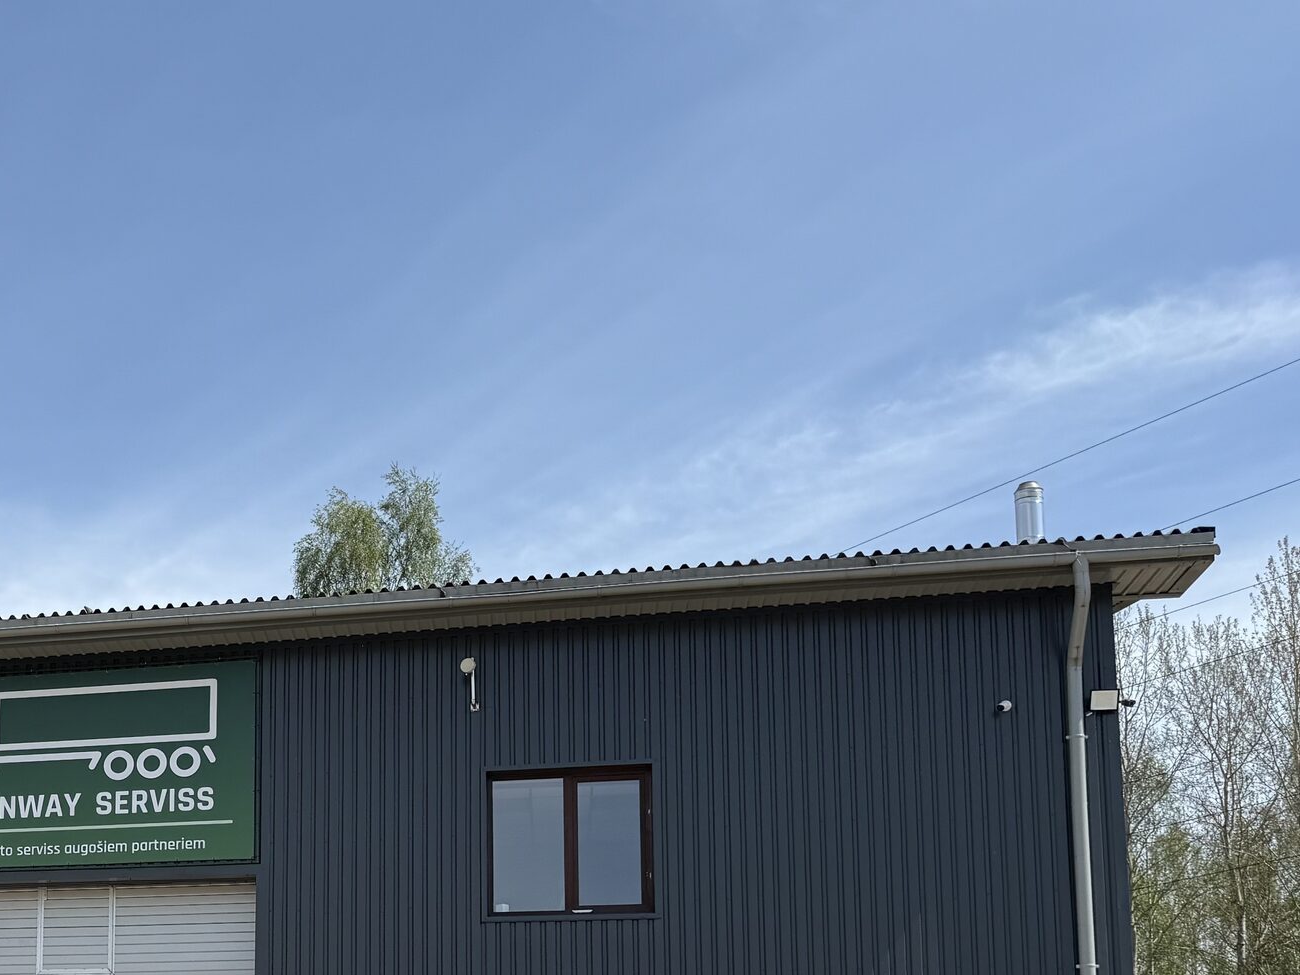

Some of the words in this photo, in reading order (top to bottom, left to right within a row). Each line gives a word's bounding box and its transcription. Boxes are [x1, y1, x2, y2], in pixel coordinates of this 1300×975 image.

[96, 786, 214, 815] SERVISS
[16, 843, 60, 856] serviss
[64, 840, 128, 856] augošiem
[131, 838, 206, 854] partneriem
